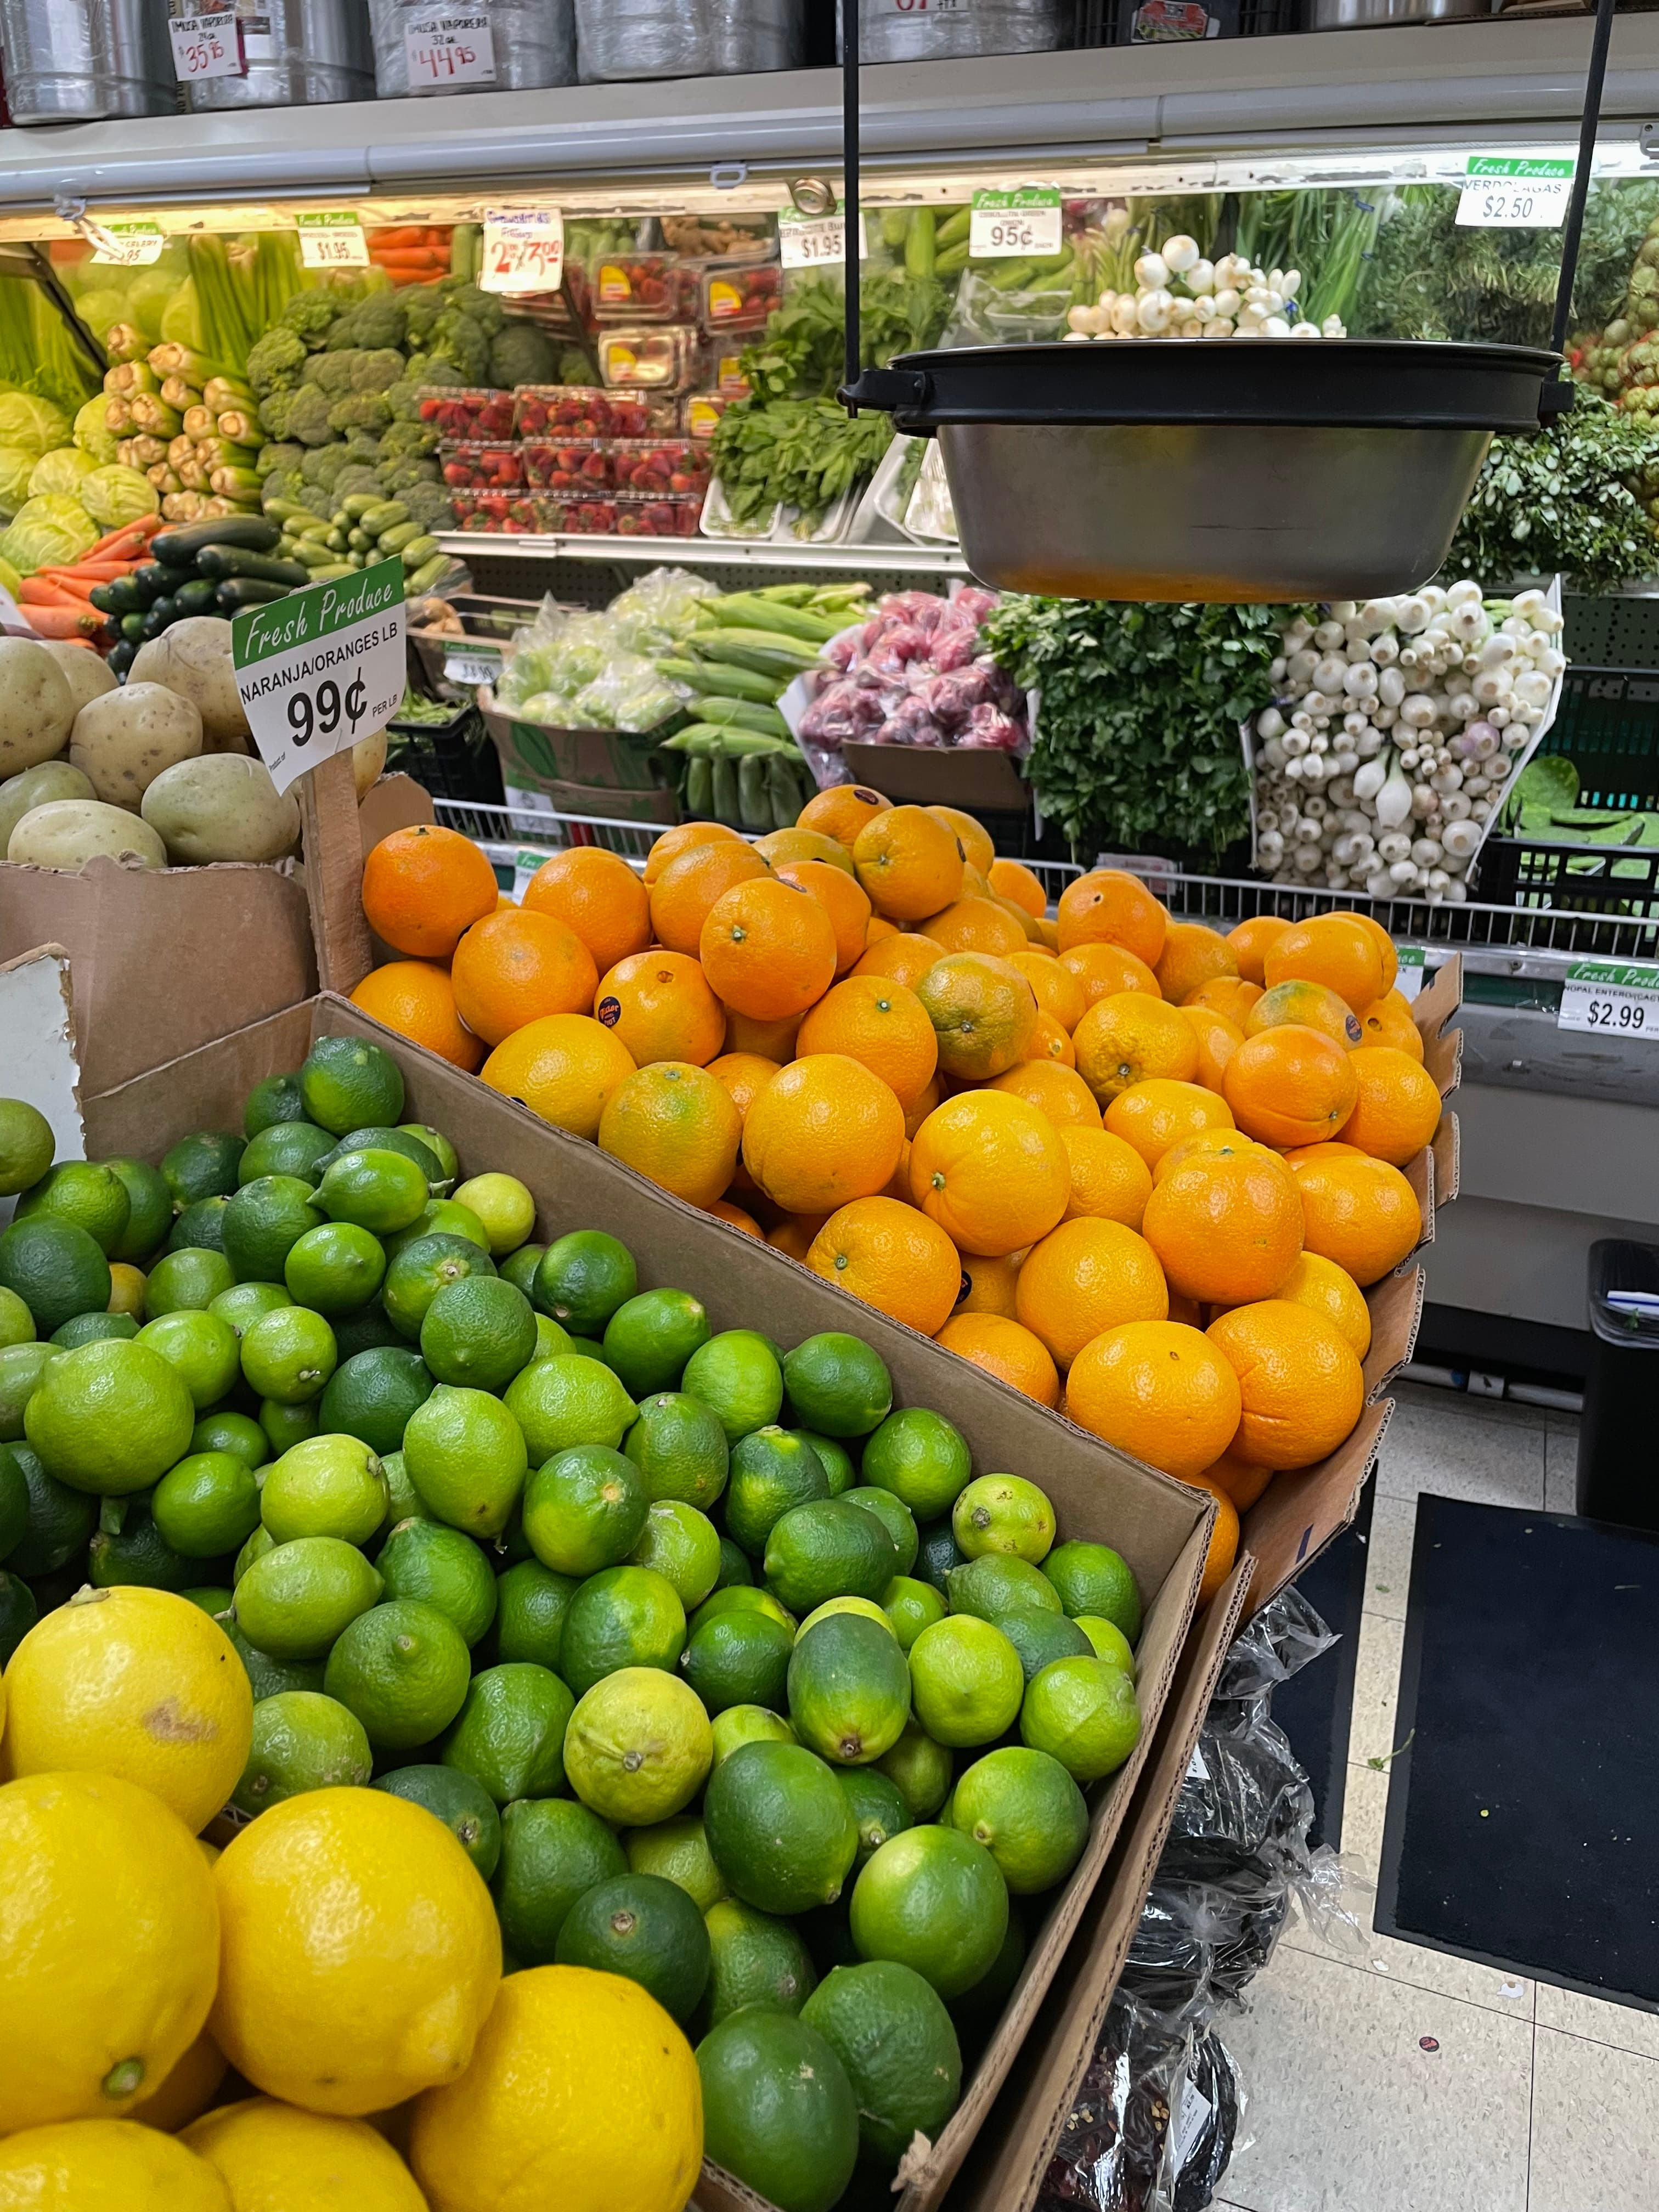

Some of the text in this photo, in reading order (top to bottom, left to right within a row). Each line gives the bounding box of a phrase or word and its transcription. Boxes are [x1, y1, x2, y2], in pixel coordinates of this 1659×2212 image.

[1472, 159, 1565, 176] Fresh Produce
[1483, 195, 1533, 218] $2.50
[802, 234, 842, 258] $1.95
[991, 225, 1033, 250] 95¢
[245, 578, 393, 659] Fresh Produce
[240, 622, 398, 705] NARANJA/ORANGES LB
[287, 667, 368, 747] 99¢
[373, 693, 397, 718] PER LB
[1573, 963, 1617, 983] Fresh
[1588, 999, 1645, 1029] $2.99
